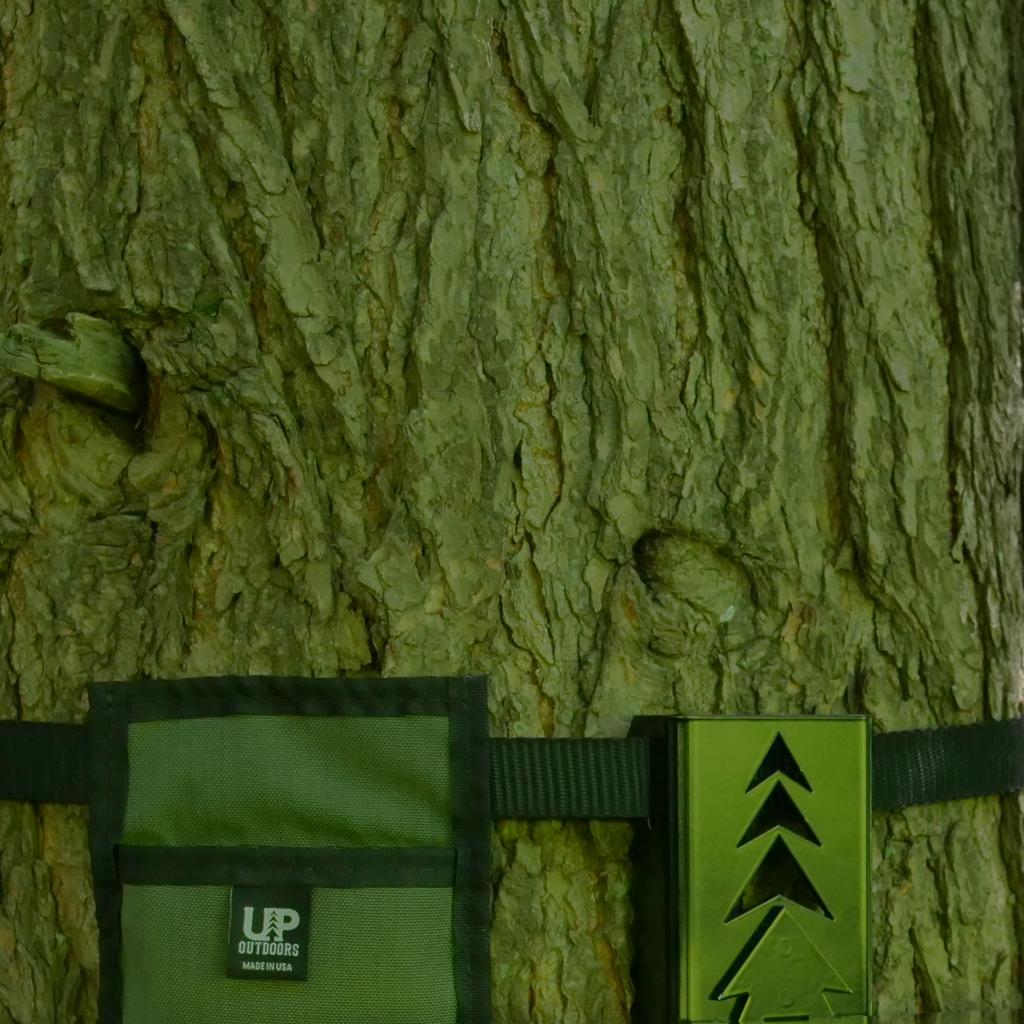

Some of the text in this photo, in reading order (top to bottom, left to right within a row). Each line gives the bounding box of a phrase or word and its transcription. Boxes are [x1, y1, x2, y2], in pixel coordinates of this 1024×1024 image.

[243, 907, 300, 942] UP
[238, 941, 299, 956] OUTDOORS
[242, 961, 292, 971] MADE IN USA
